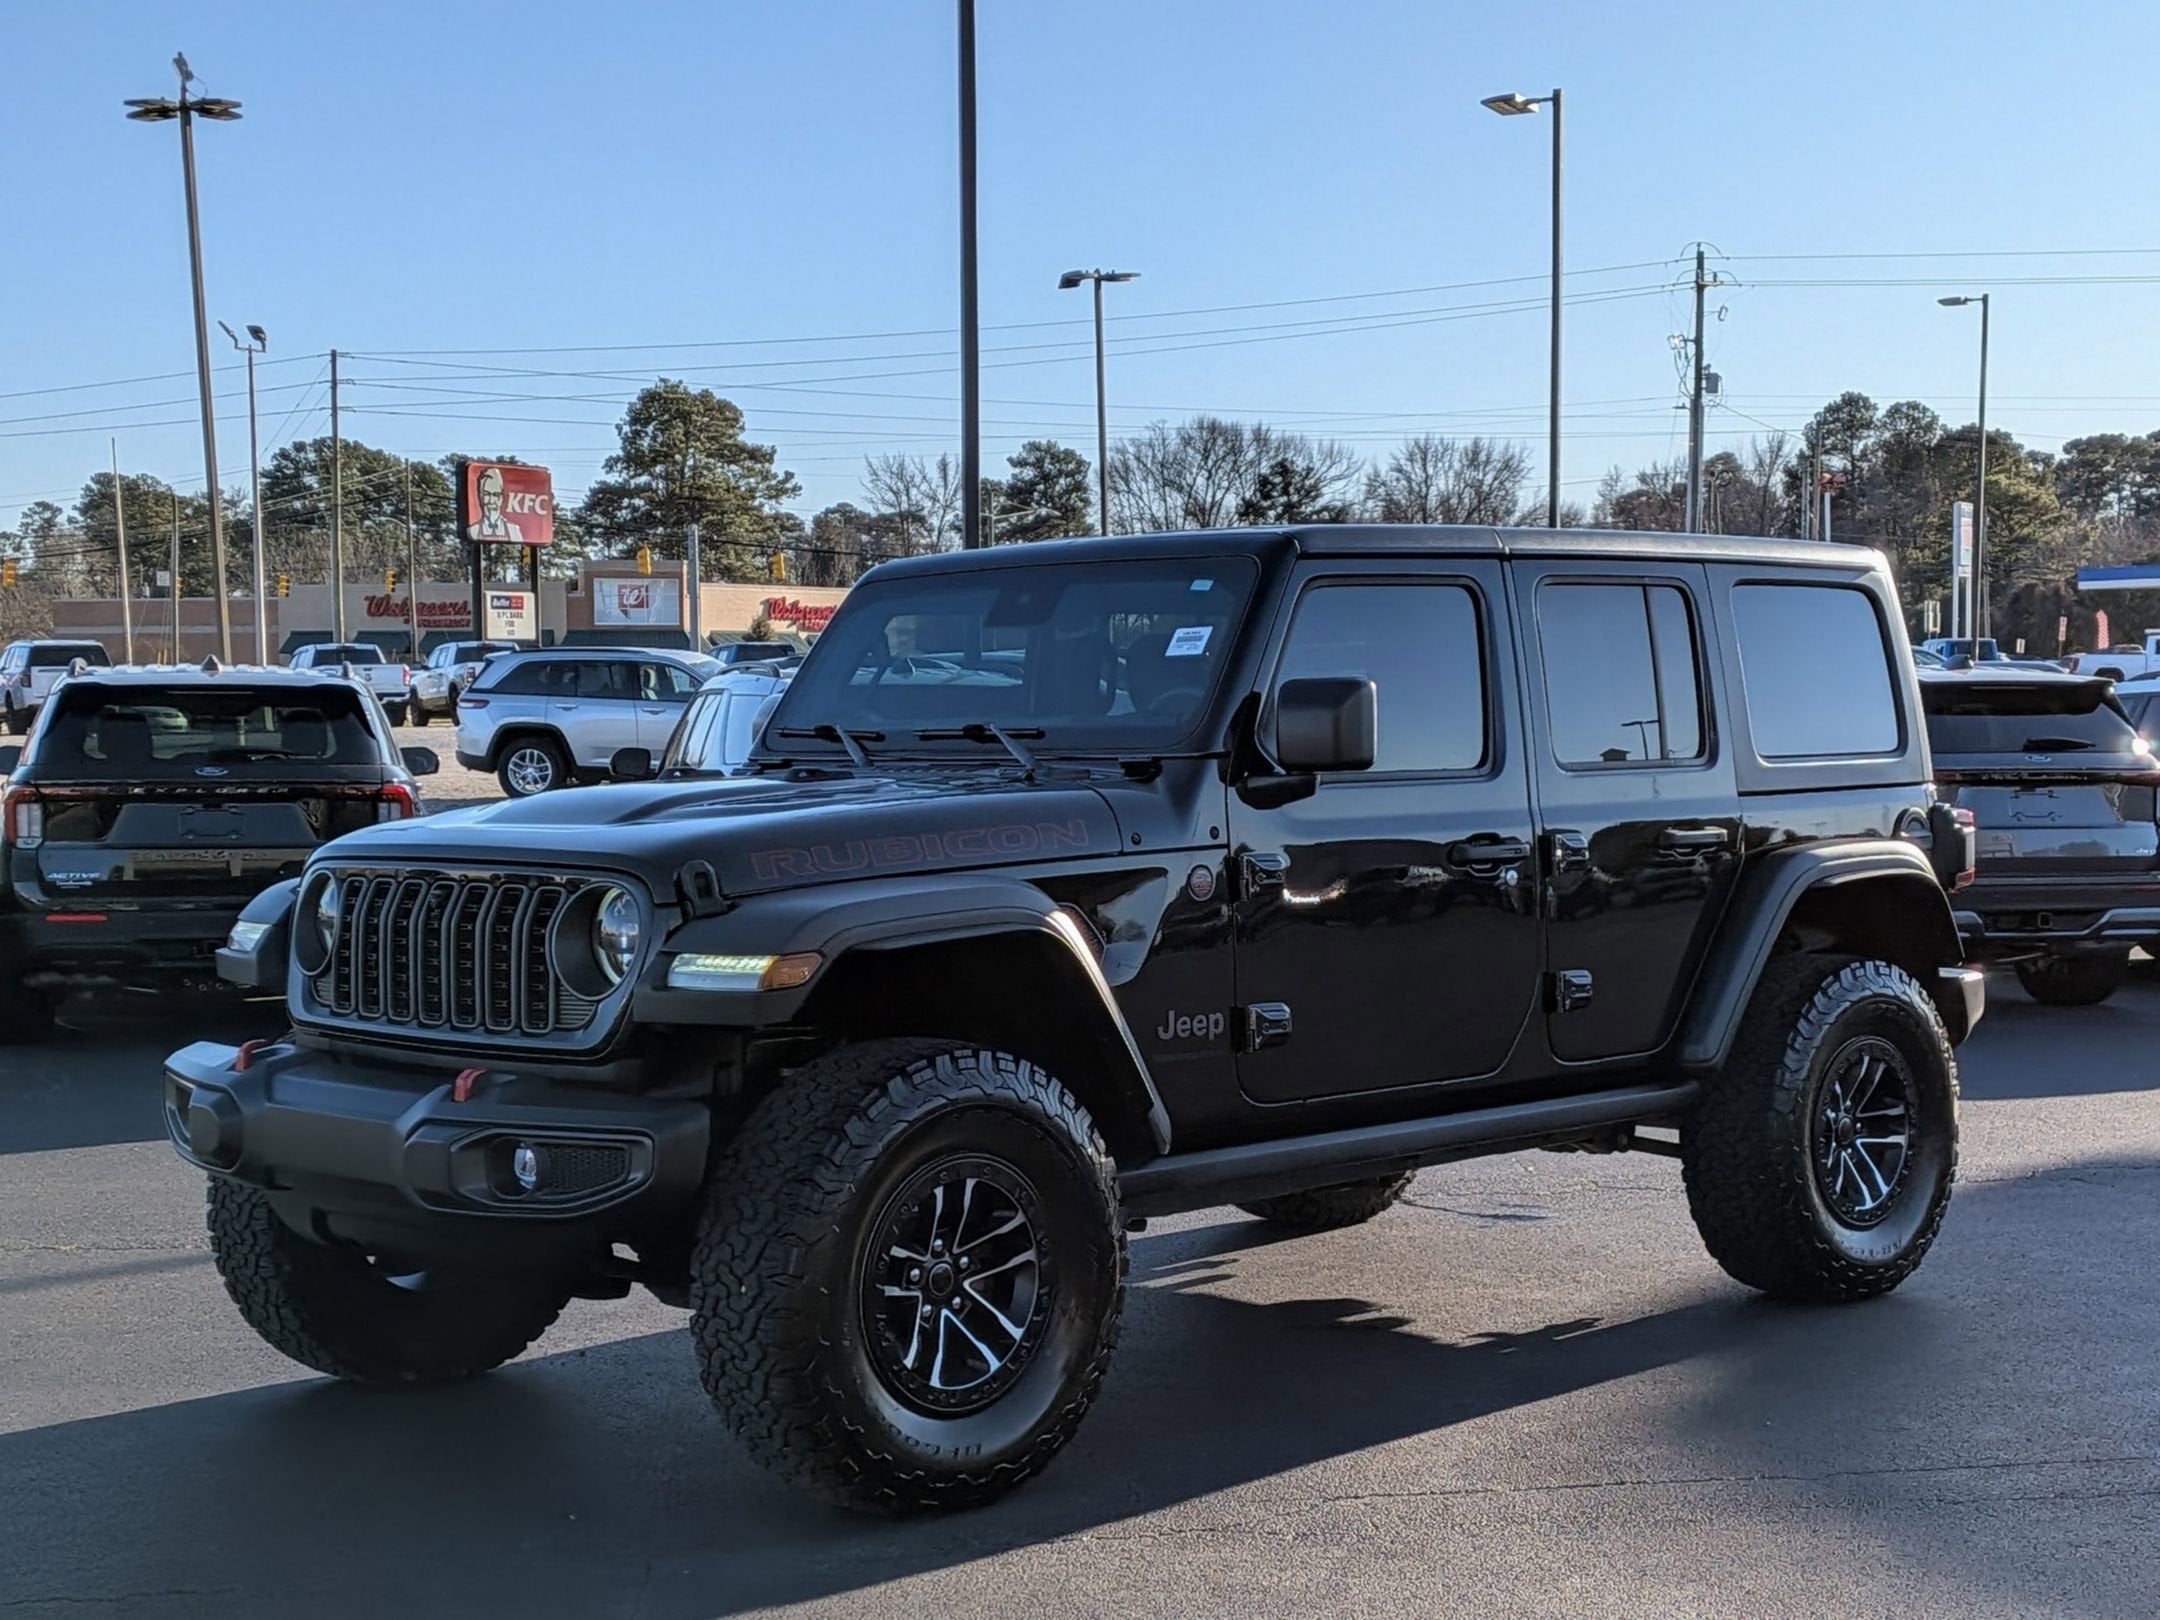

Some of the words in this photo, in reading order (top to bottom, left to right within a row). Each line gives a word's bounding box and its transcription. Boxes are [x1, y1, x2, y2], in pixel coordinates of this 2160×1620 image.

[506, 492, 549, 515] KFC
[752, 819, 1089, 880] RUBICON
[1157, 1010, 1224, 1040] Jeep
